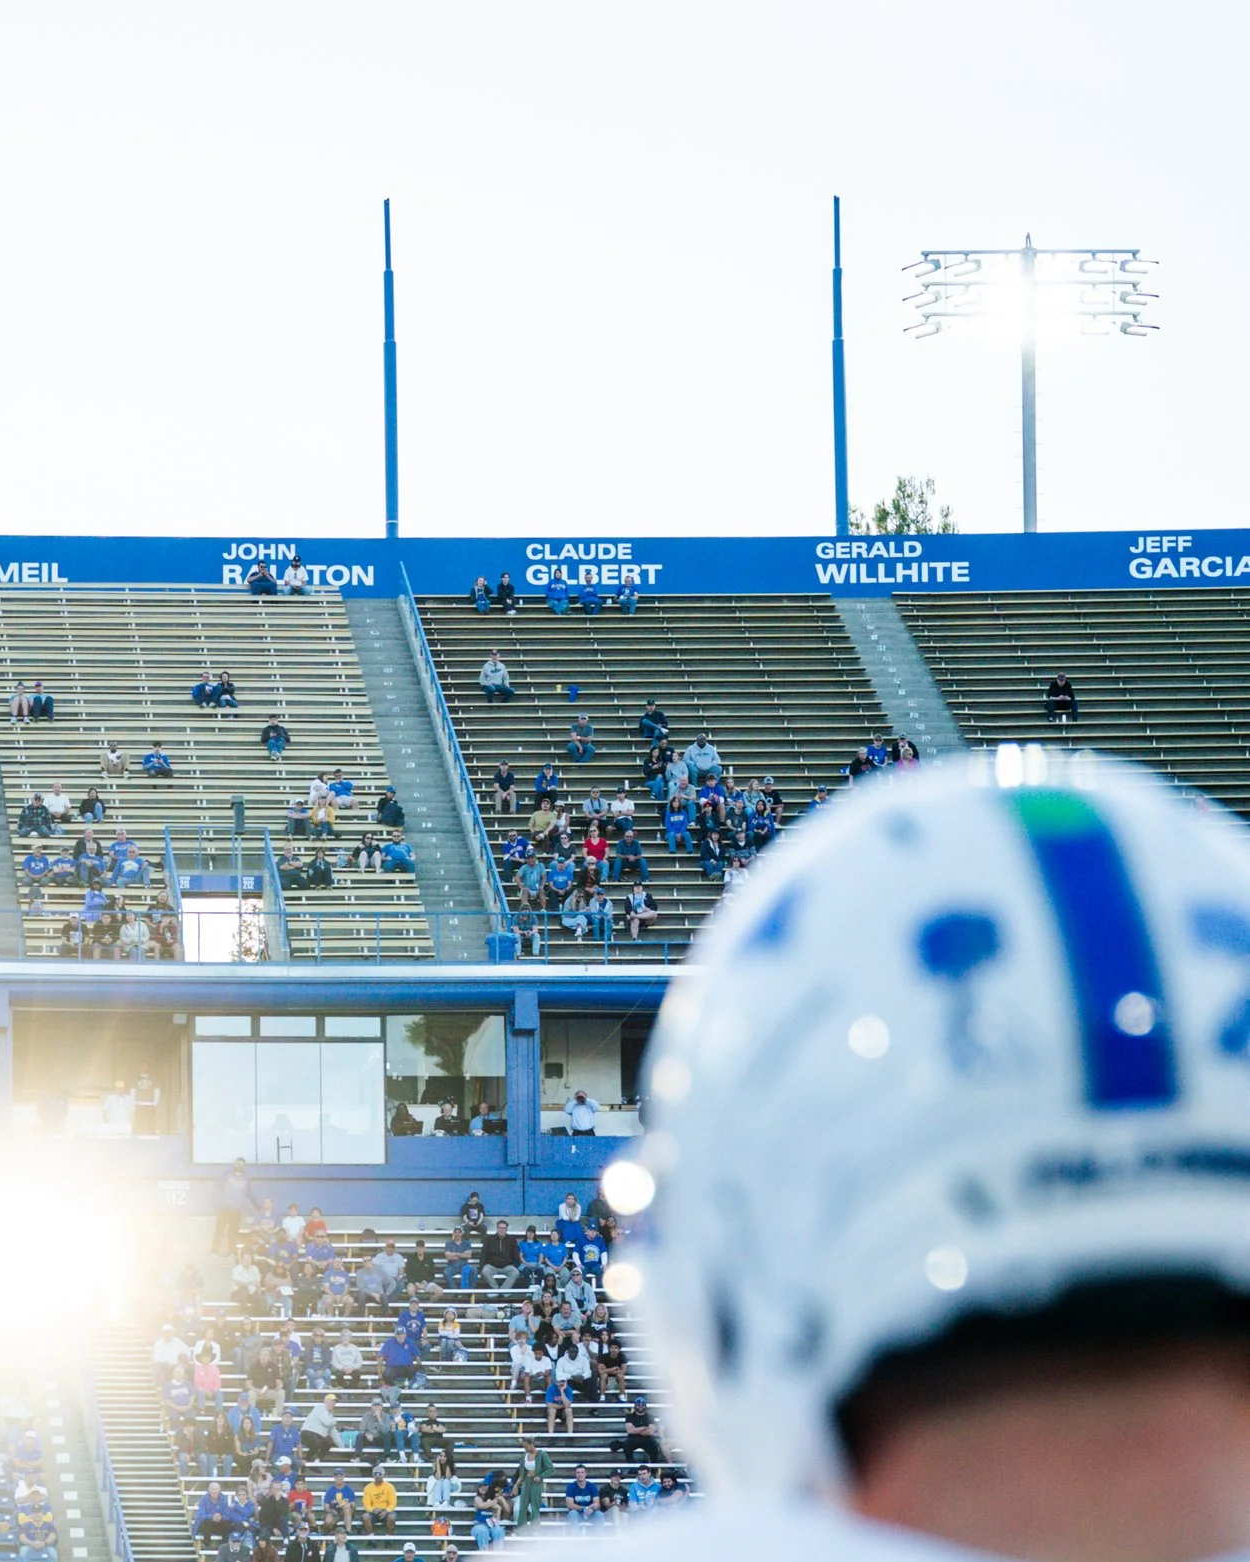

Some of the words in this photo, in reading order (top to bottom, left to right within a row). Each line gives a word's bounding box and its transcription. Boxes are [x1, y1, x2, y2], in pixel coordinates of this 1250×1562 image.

[222, 543, 296, 561] JOHN
[526, 543, 633, 560] CLAUDE
[815, 541, 923, 560] GERALD
[1129, 536, 1193, 554] JEFF
[222, 564, 375, 586] RLTON
[525, 563, 663, 586] GILBERT
[814, 560, 971, 584] WILLHITE
[1129, 555, 1250, 579] GARCIA
